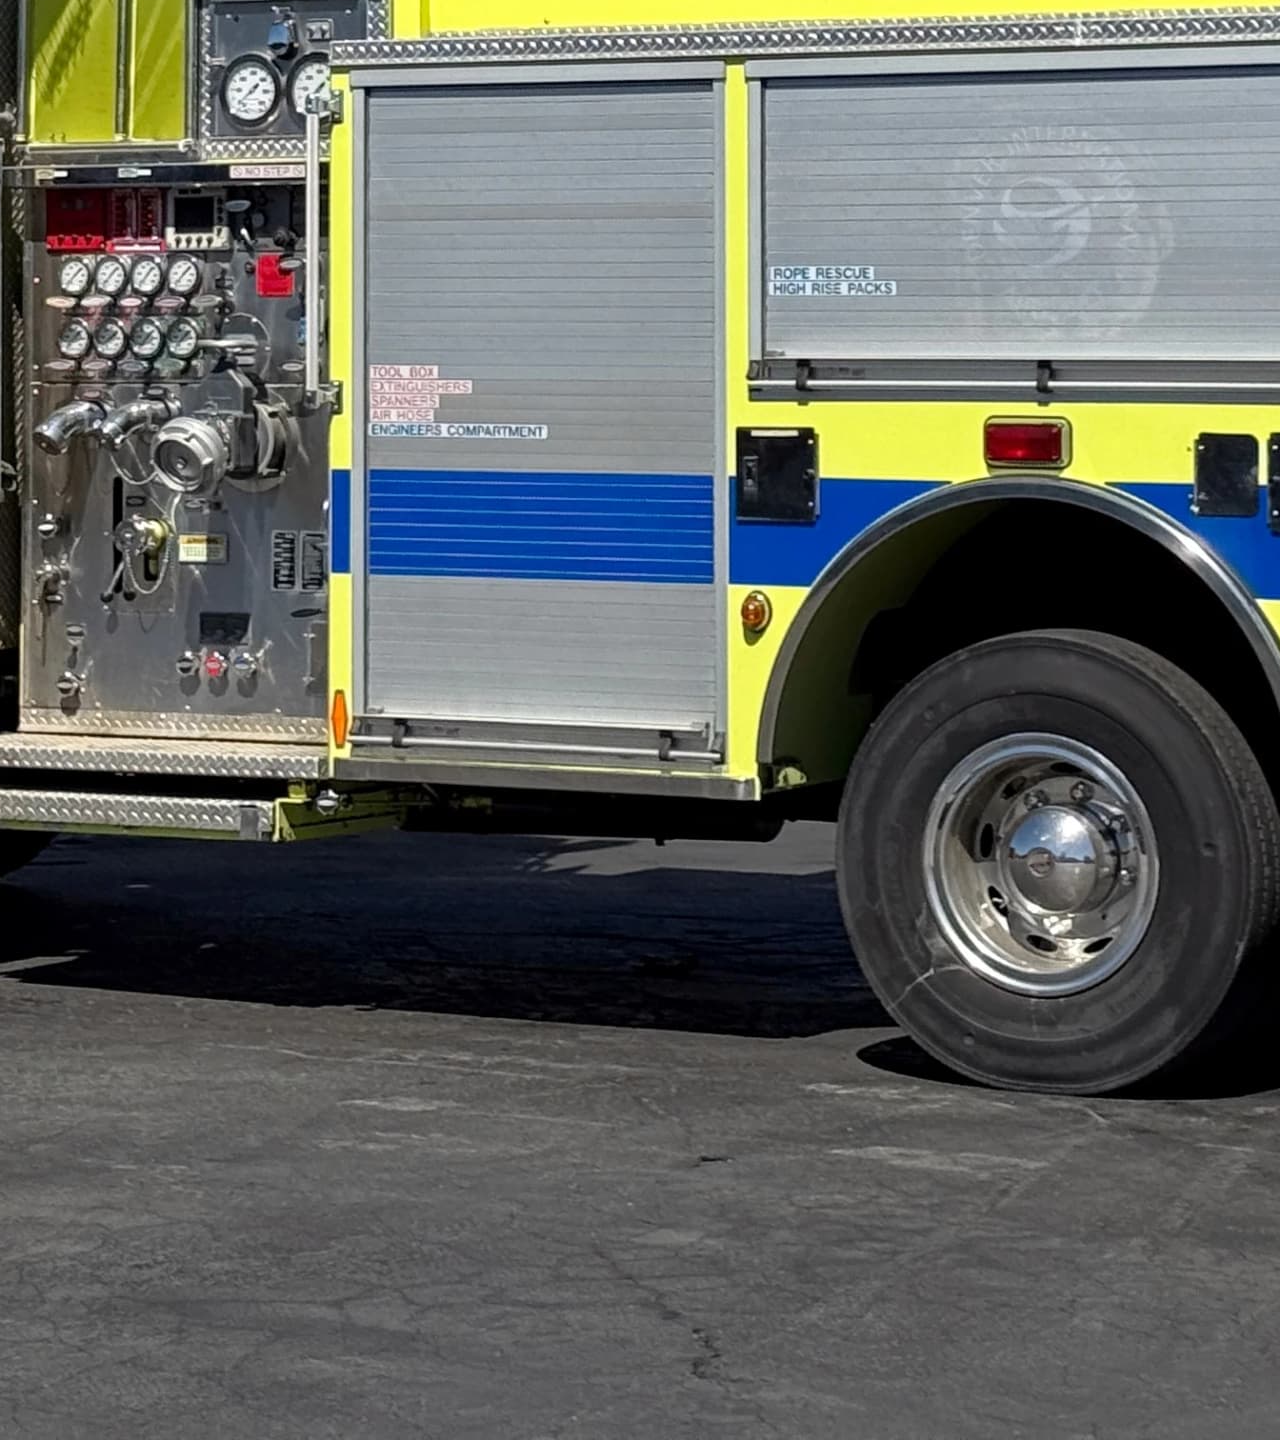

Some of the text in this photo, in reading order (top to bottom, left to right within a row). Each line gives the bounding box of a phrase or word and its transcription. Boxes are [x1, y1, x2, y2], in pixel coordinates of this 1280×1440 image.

[773, 268, 871, 279] ROPE RESCUE
[773, 283, 893, 295] HIGH RISE PACKS
[371, 367, 434, 378] TOOL BOX
[371, 381, 470, 393] EXTINGUISHERS
[371, 395, 437, 407] SPANNERS
[372, 410, 432, 421] AIR HOSE
[371, 424, 544, 437] ENGINEERS COMPARTMENT
